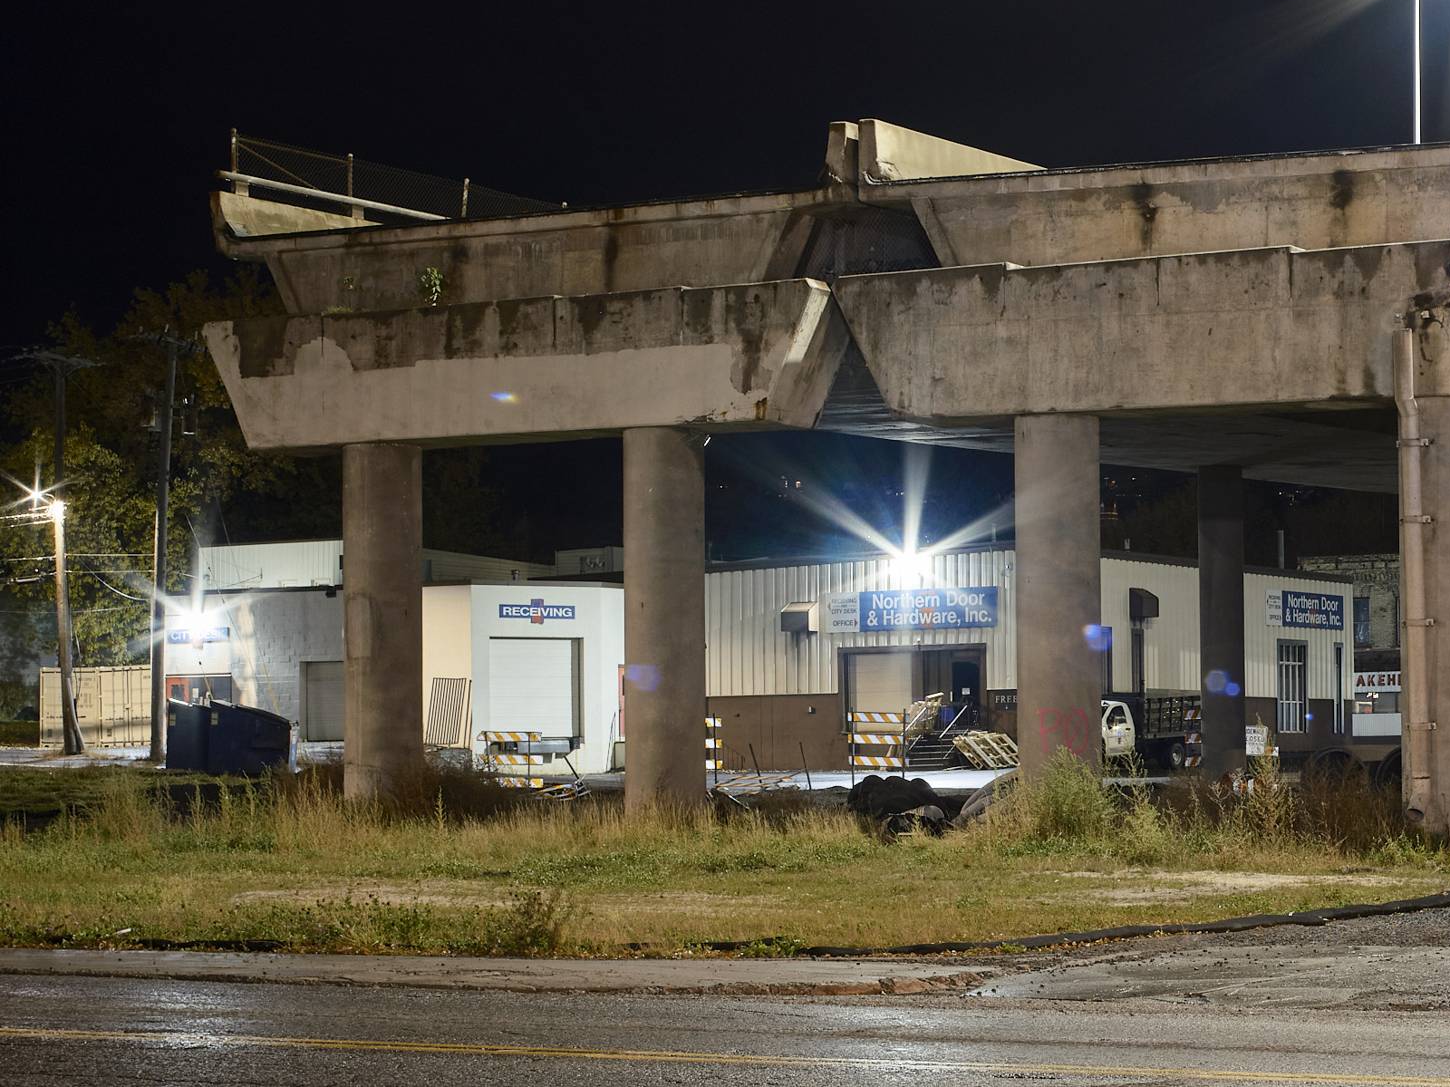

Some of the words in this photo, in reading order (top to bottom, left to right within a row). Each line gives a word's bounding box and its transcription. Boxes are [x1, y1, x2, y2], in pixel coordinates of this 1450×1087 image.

[872, 593, 940, 610] Northern
[946, 591, 985, 606] Door
[1288, 594, 1319, 610] Northern
[1321, 597, 1338, 611] Door
[503, 606, 573, 617] RECEIVING
[867, 611, 878, 626] &
[883, 609, 961, 626] Hardware,
[965, 607, 992, 624] Inc.
[1286, 608, 1291, 622] &
[1293, 609, 1328, 627] Hardware,
[1330, 612, 1342, 626] Inc.
